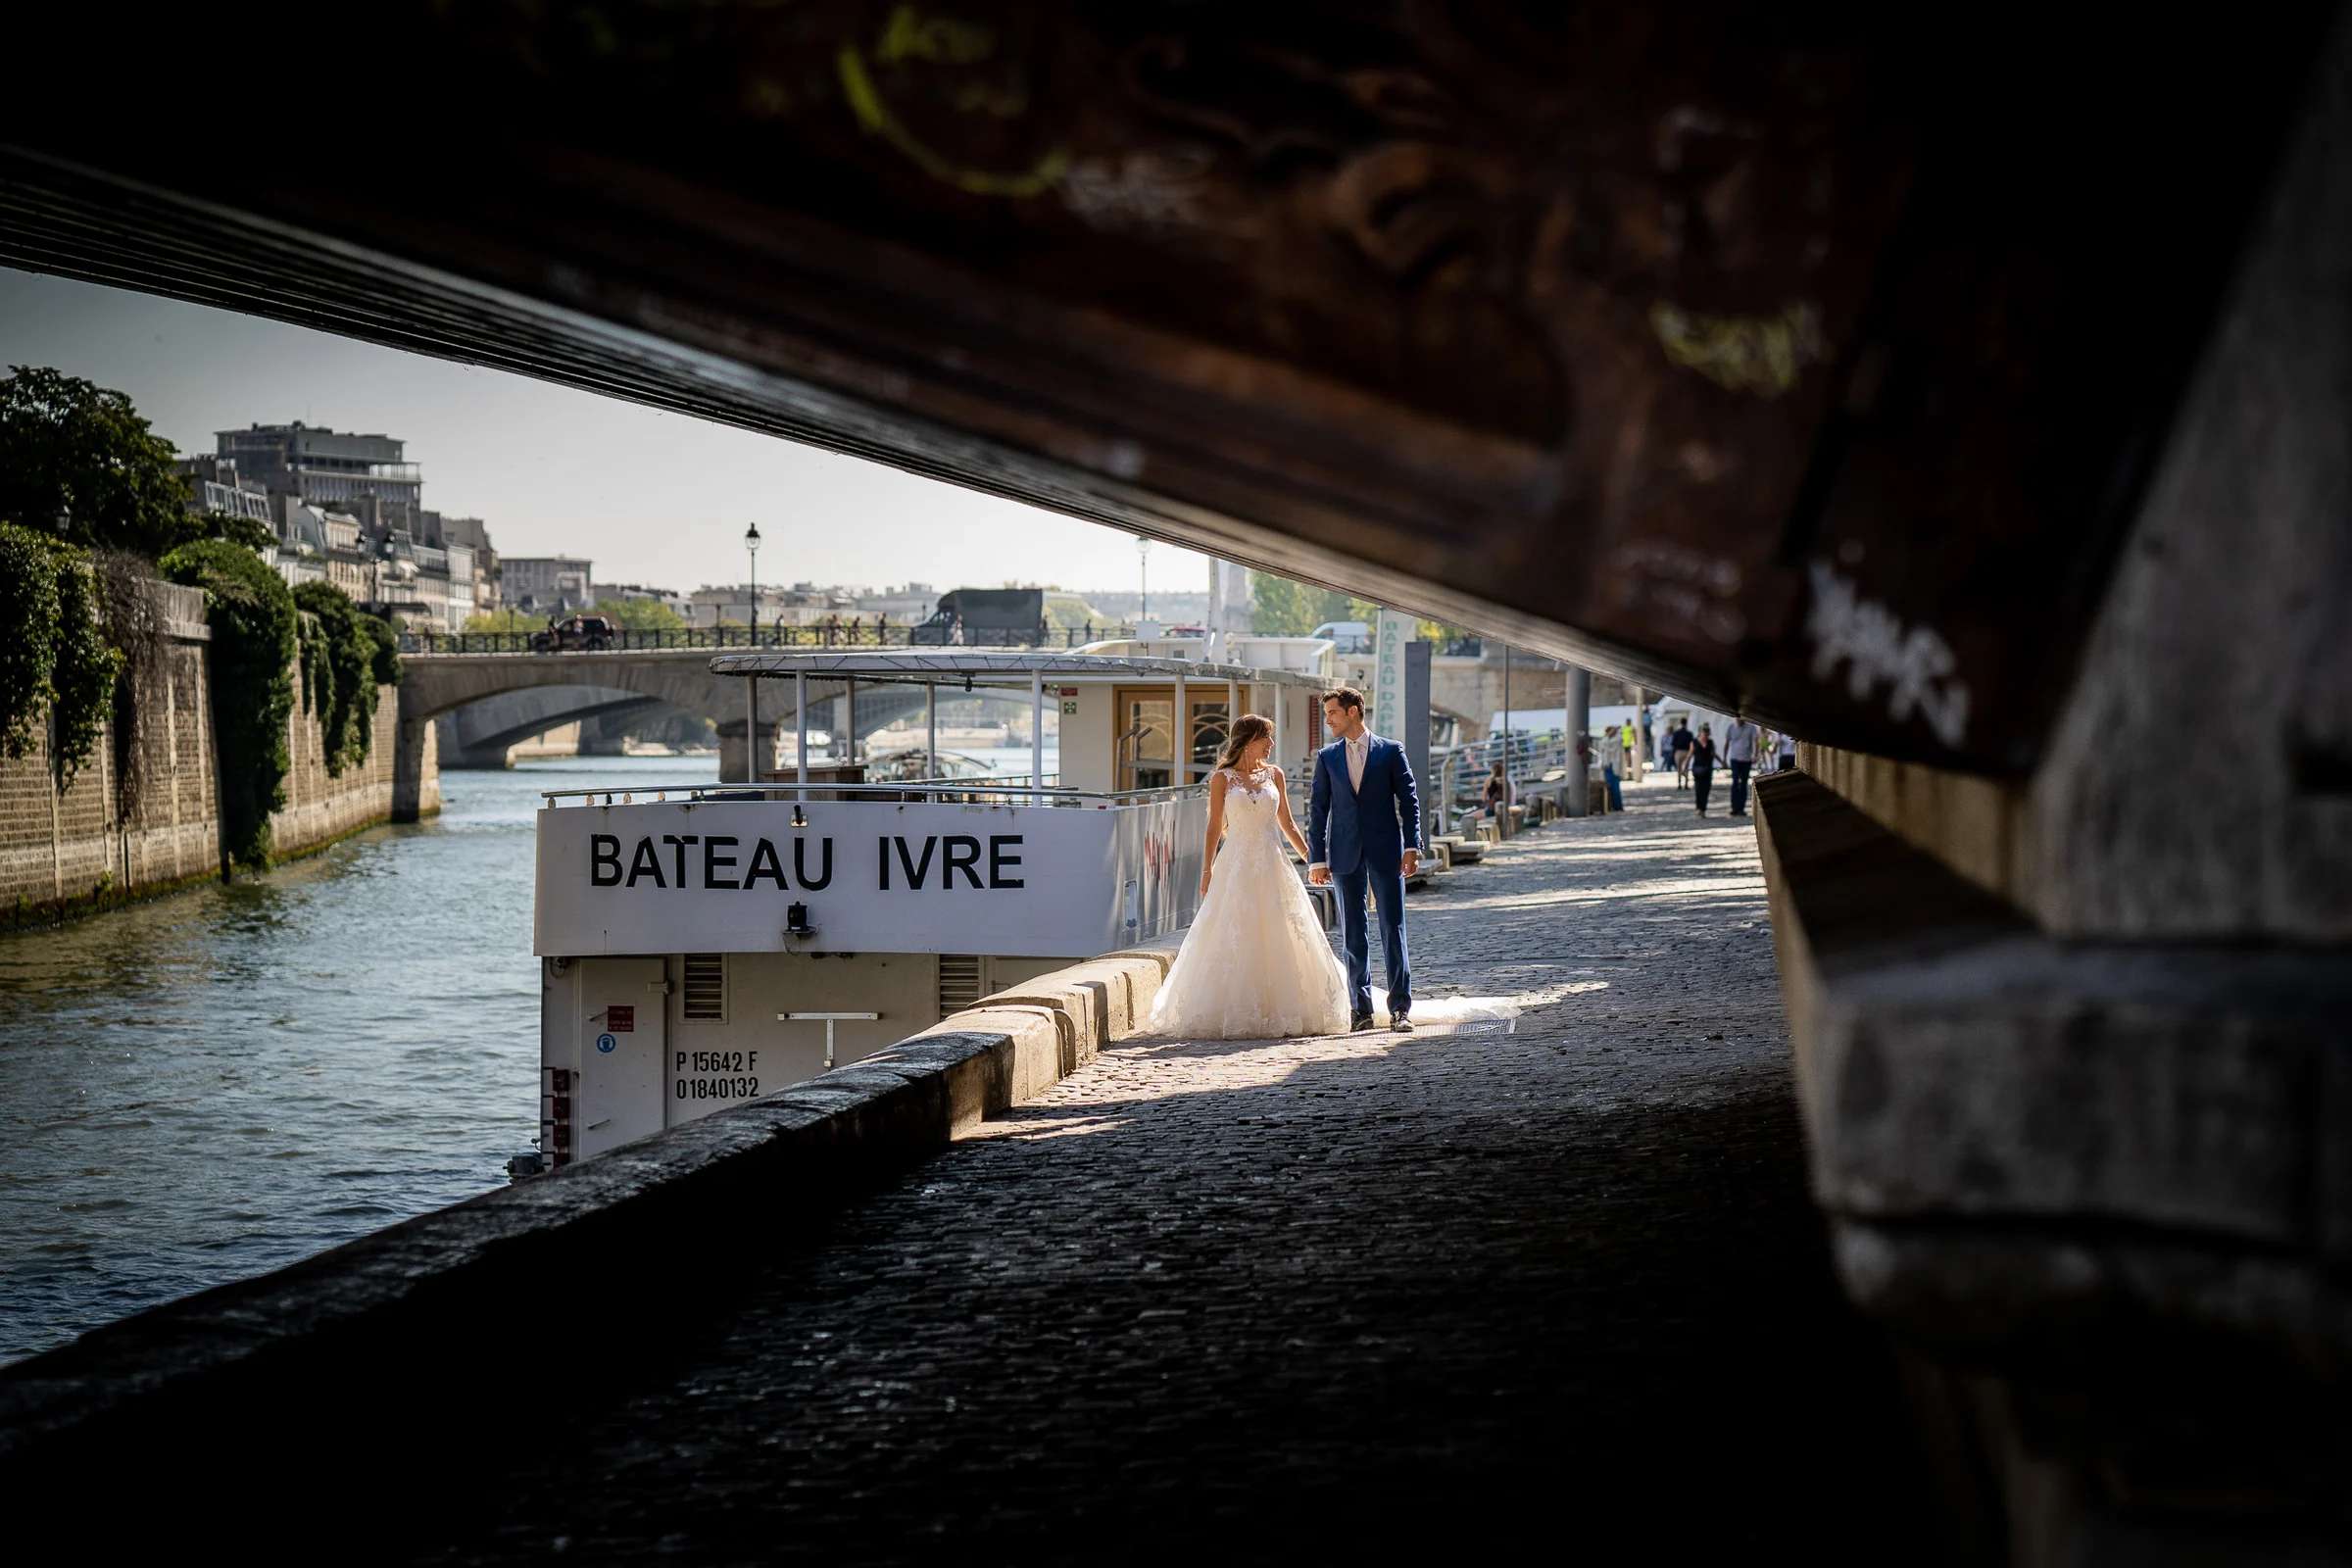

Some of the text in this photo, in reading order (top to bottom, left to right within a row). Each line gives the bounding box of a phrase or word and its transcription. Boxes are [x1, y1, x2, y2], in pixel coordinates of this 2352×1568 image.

[1381, 620, 1398, 686] BATEAU
[590, 834, 1025, 892] BATEAU IVRE
[676, 1051, 759, 1073] P 15642 F
